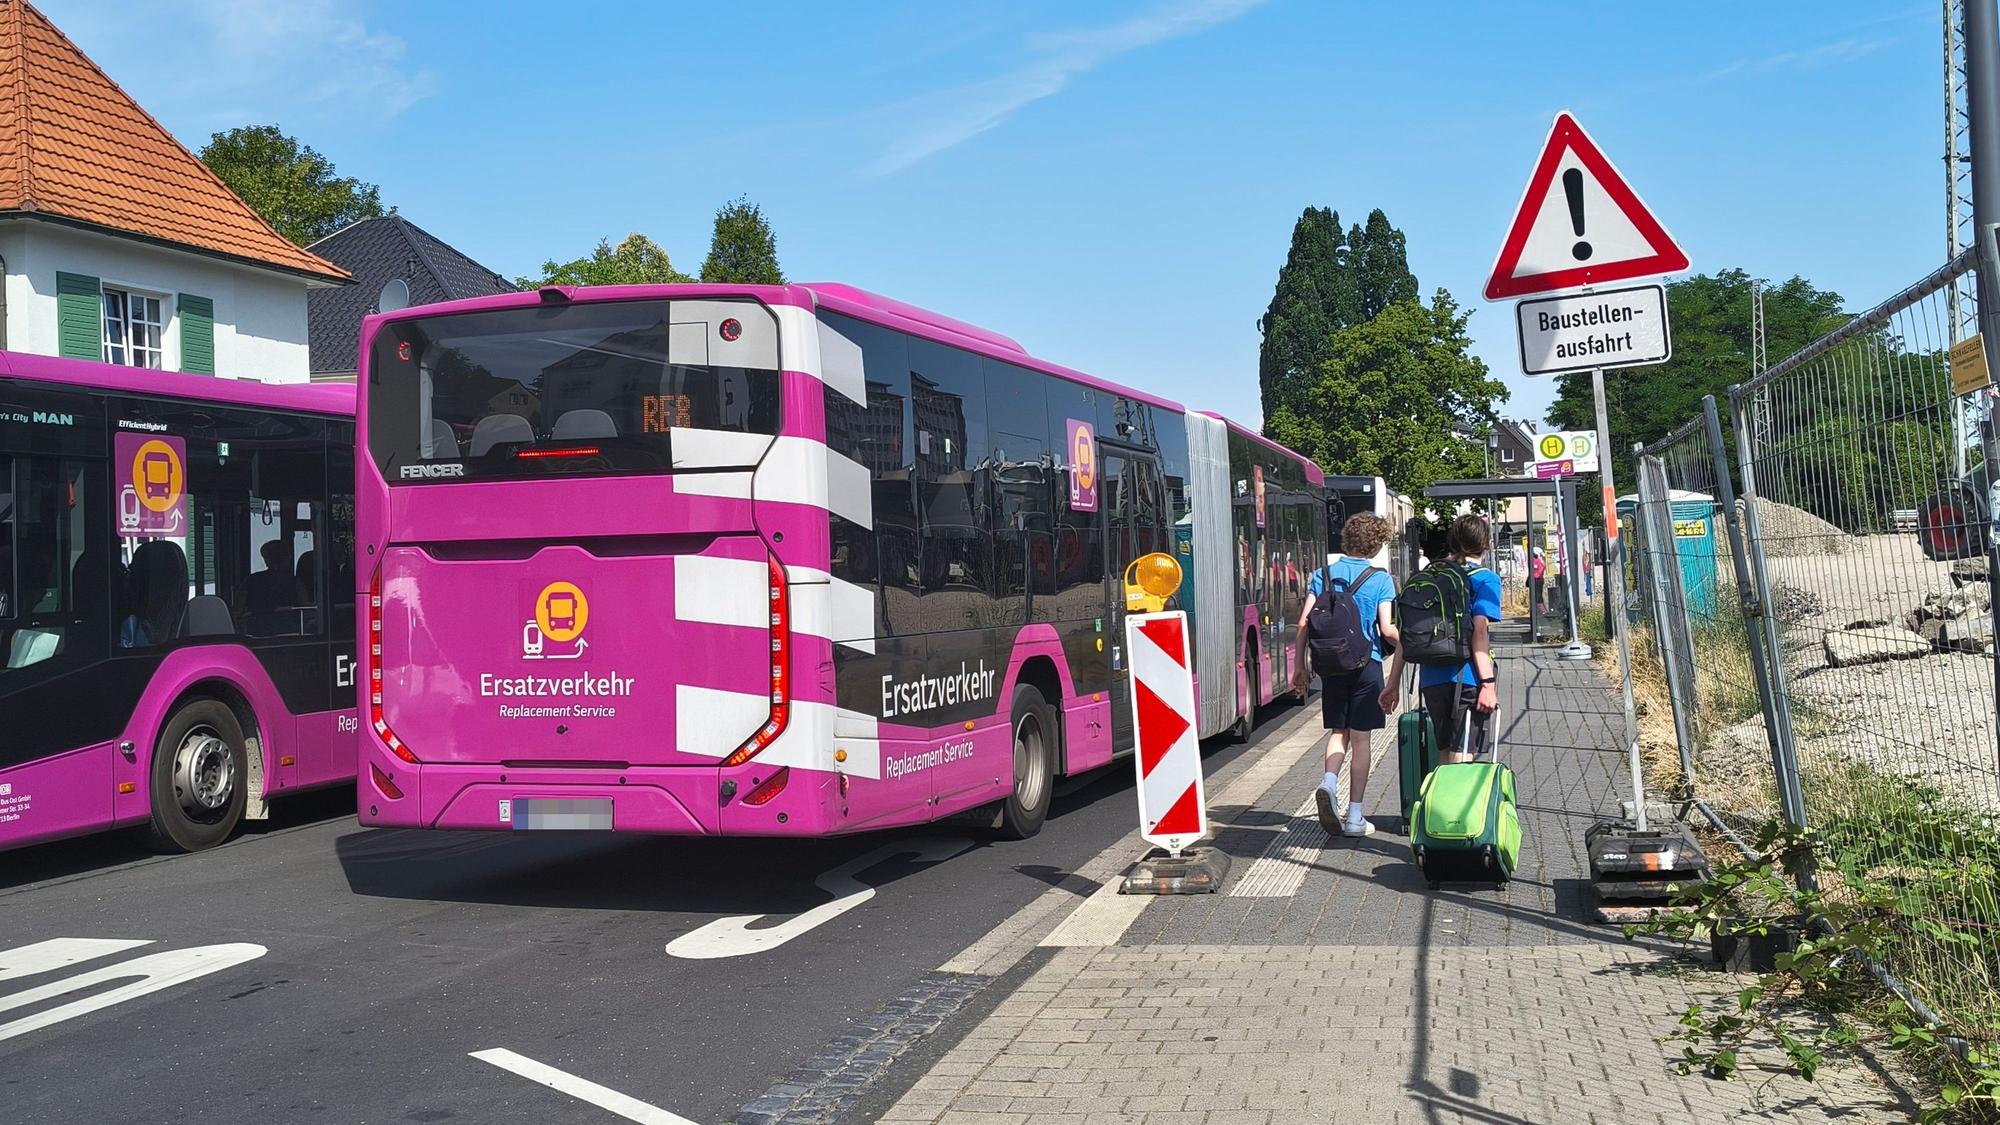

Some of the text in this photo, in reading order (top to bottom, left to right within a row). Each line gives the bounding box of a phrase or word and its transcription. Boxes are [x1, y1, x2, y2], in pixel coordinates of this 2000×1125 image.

[1538, 304, 1643, 332] Baustellen-
[1556, 332, 1632, 358] ausfahrt
[13, 413, 28, 423] City
[33, 411, 73, 425] MAN
[643, 394, 691, 432] RE8
[400, 463, 464, 478] FENCER
[480, 671, 635, 696] Ersatzverkehr
[882, 659, 995, 718] Ersatzverkehr
[499, 704, 616, 719] Replacement Service
[886, 738, 974, 780] Replacement Service
